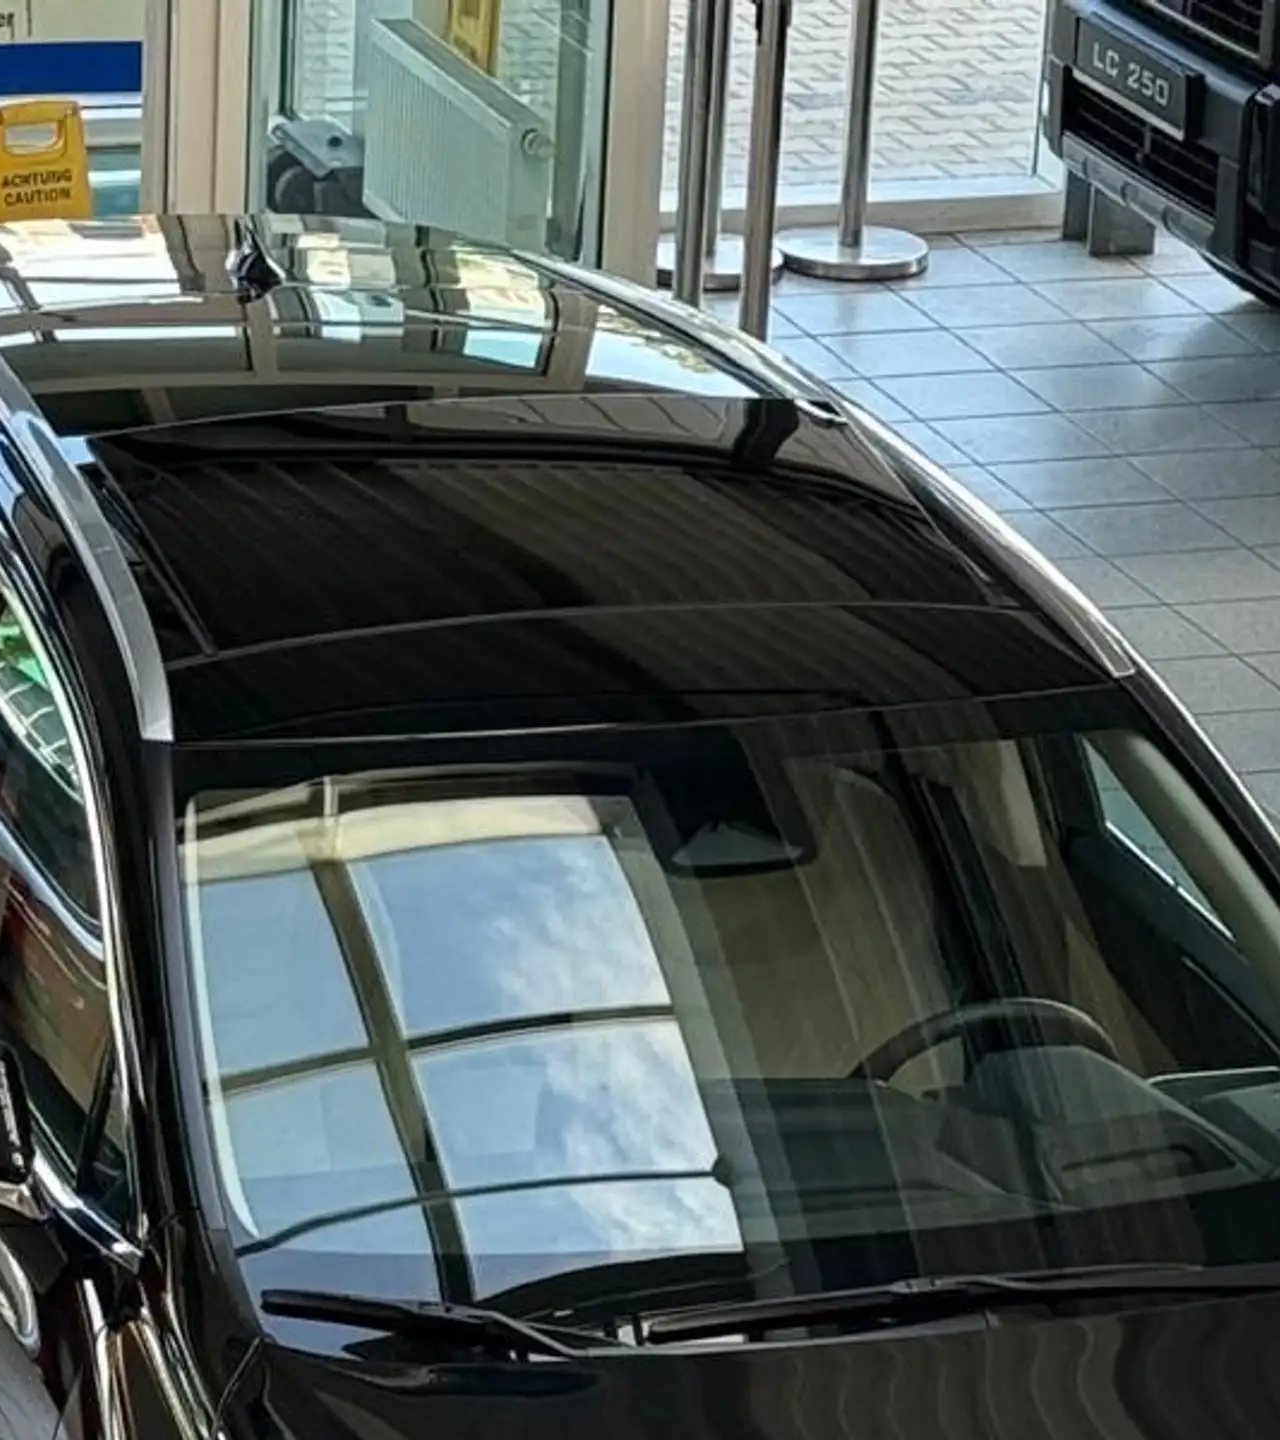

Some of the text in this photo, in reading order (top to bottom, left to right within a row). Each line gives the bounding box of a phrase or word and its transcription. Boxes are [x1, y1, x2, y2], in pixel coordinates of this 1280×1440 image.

[1093, 42, 1169, 106] LC 250
[1, 169, 73, 190] ACHTUNG
[4, 188, 71, 207] CAUTION
